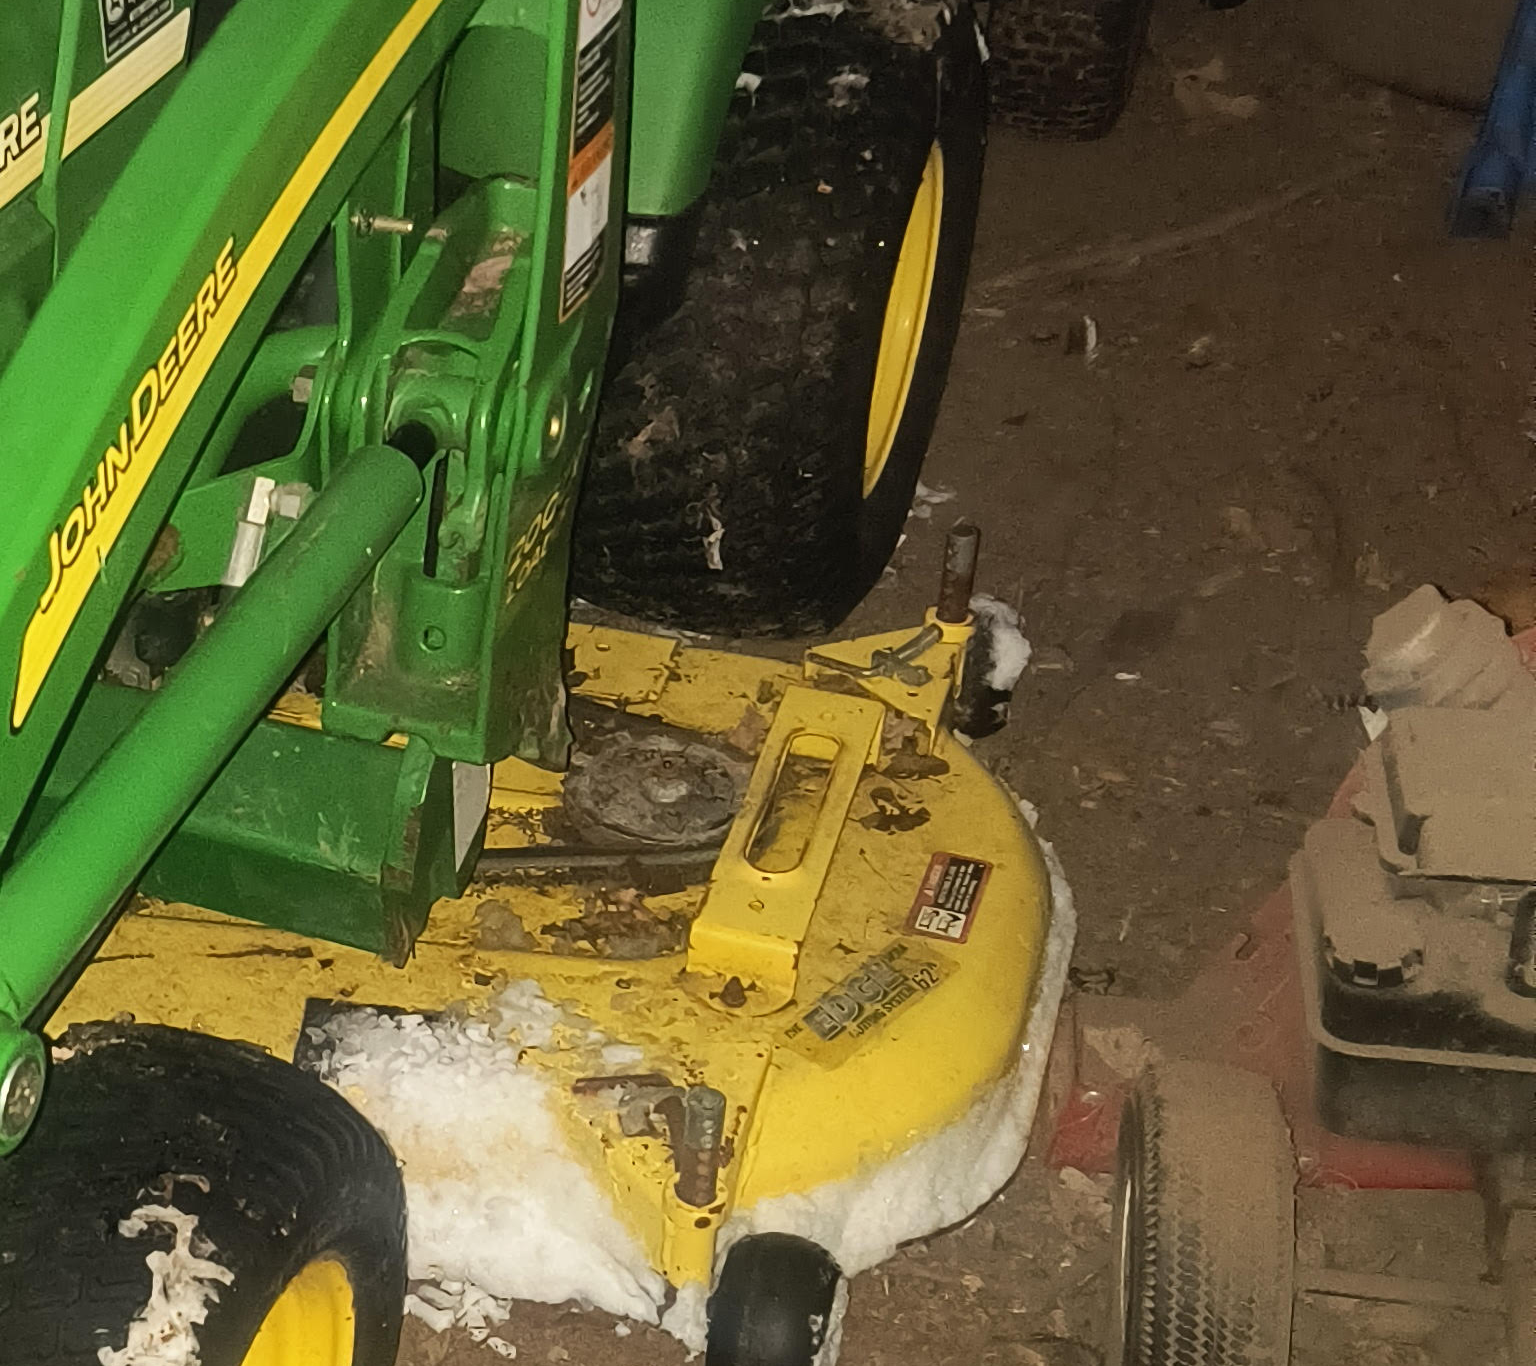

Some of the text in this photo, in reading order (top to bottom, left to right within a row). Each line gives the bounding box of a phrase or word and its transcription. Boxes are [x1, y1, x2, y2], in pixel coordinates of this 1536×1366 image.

[39, 235, 238, 613] JOHN DEERE
[801, 953, 911, 1042] EDGE
